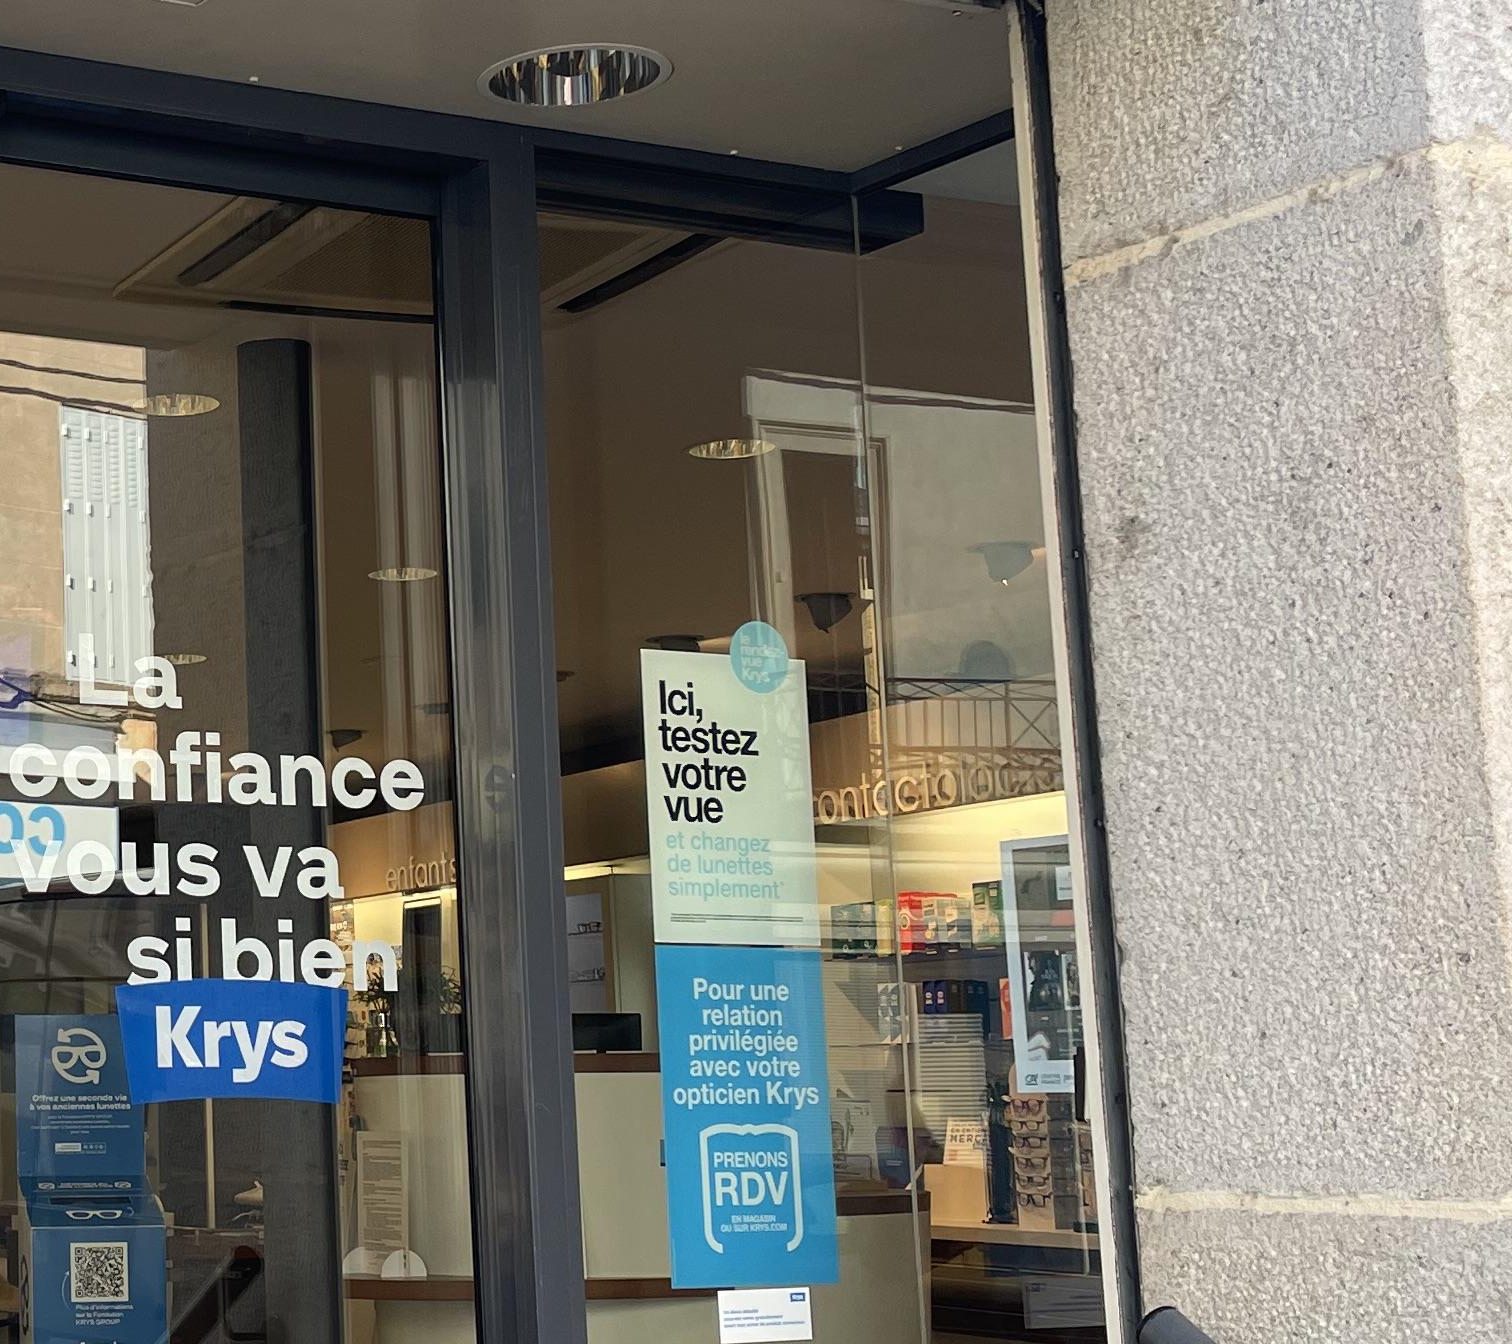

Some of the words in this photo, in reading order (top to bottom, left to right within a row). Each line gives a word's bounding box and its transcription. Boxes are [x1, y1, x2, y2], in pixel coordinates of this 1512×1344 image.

[79, 633, 183, 709] La
[658, 679, 703, 723] Ici,
[658, 719, 759, 757] testez
[8, 731, 425, 811] confiance
[662, 757, 747, 792] votre
[664, 794, 723, 824] vue
[666, 831, 685, 850] et
[691, 831, 771, 857] changez
[12, 839, 222, 898] vous
[242, 843, 344, 899] va
[386, 852, 457, 892] enfants
[668, 853, 691, 872] de
[698, 855, 773, 877] lunettes
[127, 917, 192, 987] si
[222, 918, 399, 992] bien
[693, 977, 745, 1001] Pour
[750, 983, 790, 1001] une
[702, 1004, 783, 1026] relation
[155, 1004, 308, 1083] Krys
[689, 1029, 799, 1057] privilégiée
[690, 1058, 740, 1077] avec
[746, 1056, 801, 1077] votre
[673, 1083, 760, 1110] opticien
[766, 1081, 819, 1110] Krys
[713, 1150, 789, 1169] PRENONS
[714, 1171, 789, 1207] RDV
